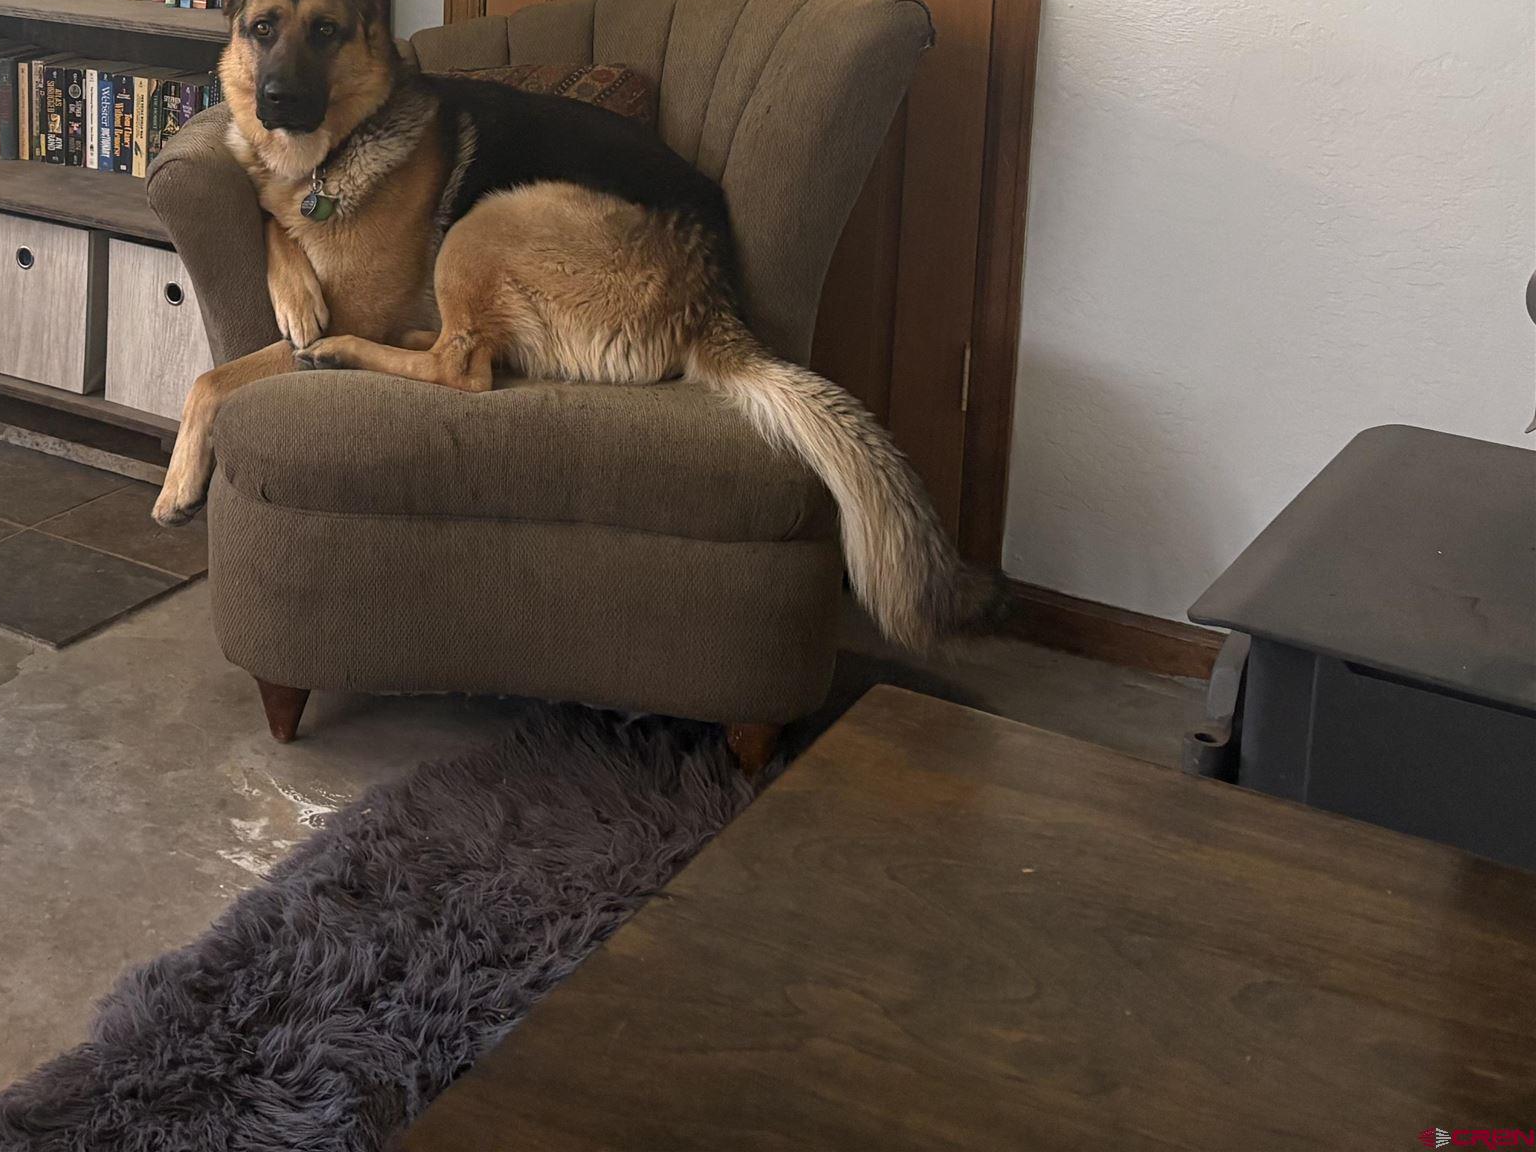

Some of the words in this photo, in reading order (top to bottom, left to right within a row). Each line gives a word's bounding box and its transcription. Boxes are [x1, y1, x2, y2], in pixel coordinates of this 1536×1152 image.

[46, 80, 55, 112] SHRUGGED
[54, 88, 62, 106] ATLAS
[100, 86, 111, 127] Webster
[114, 103, 124, 128] Without
[124, 113, 132, 127] Tom
[47, 133, 55, 151] RAND
[100, 127, 112, 158] DICTIONARY
[114, 128, 124, 156] Remorse
[122, 127, 132, 148] Clancy
